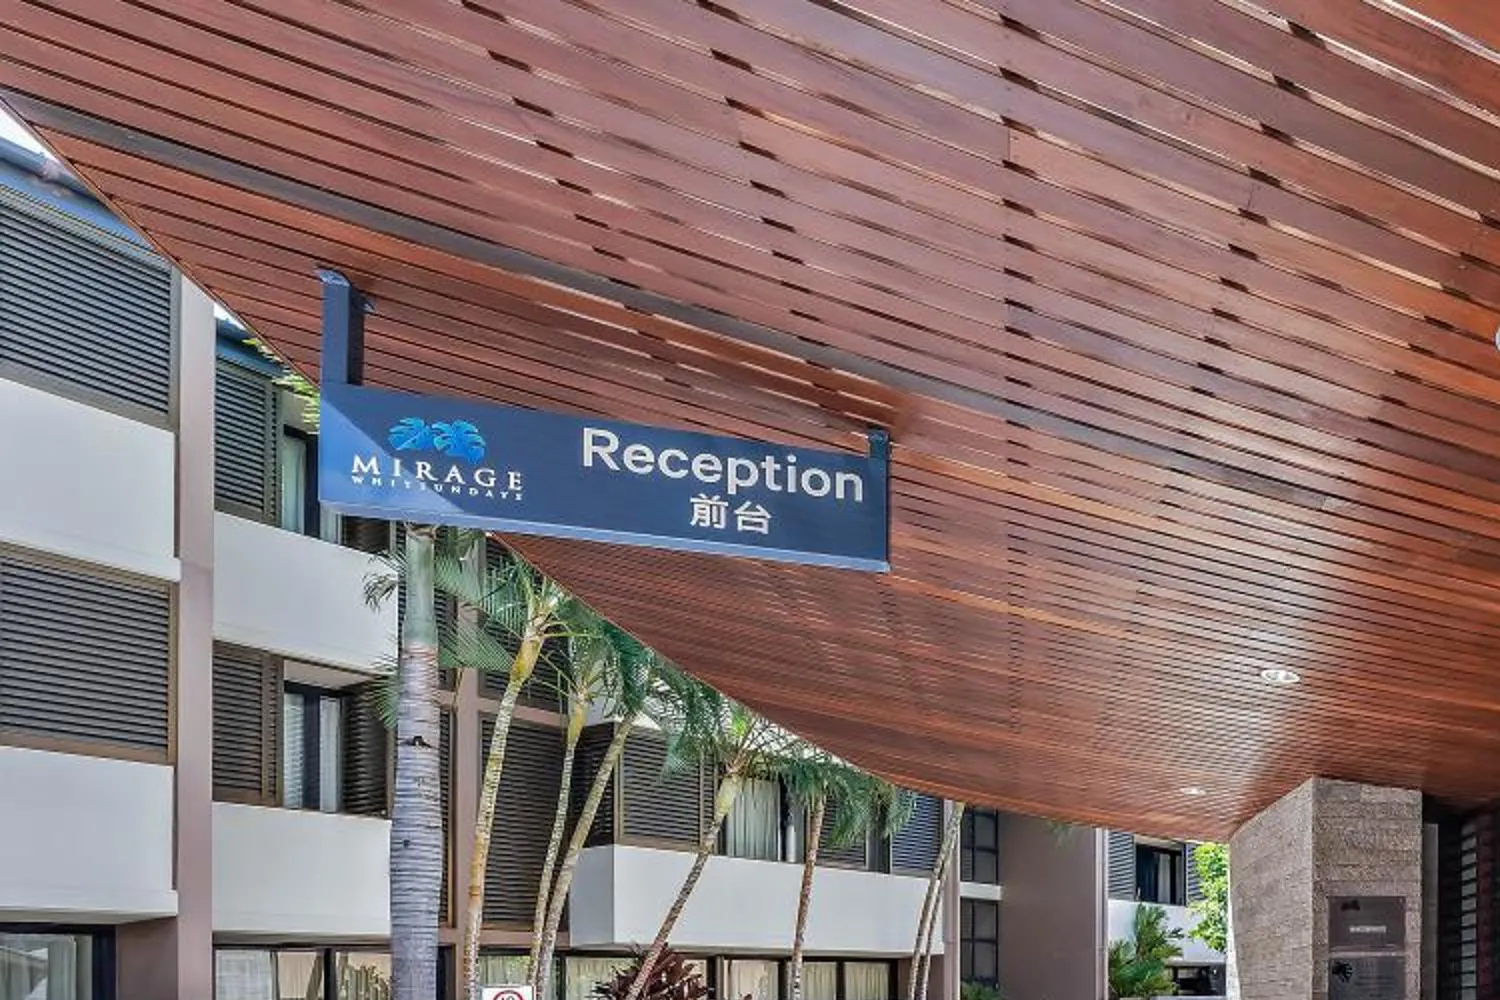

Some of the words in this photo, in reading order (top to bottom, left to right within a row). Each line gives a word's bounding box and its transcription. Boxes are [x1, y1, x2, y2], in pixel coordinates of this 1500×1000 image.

[352, 455, 522, 490] MIRAGE
[582, 427, 863, 501] Reception
[352, 475, 523, 501] WHITSUNDAYS
[690, 494, 772, 535] 前台
